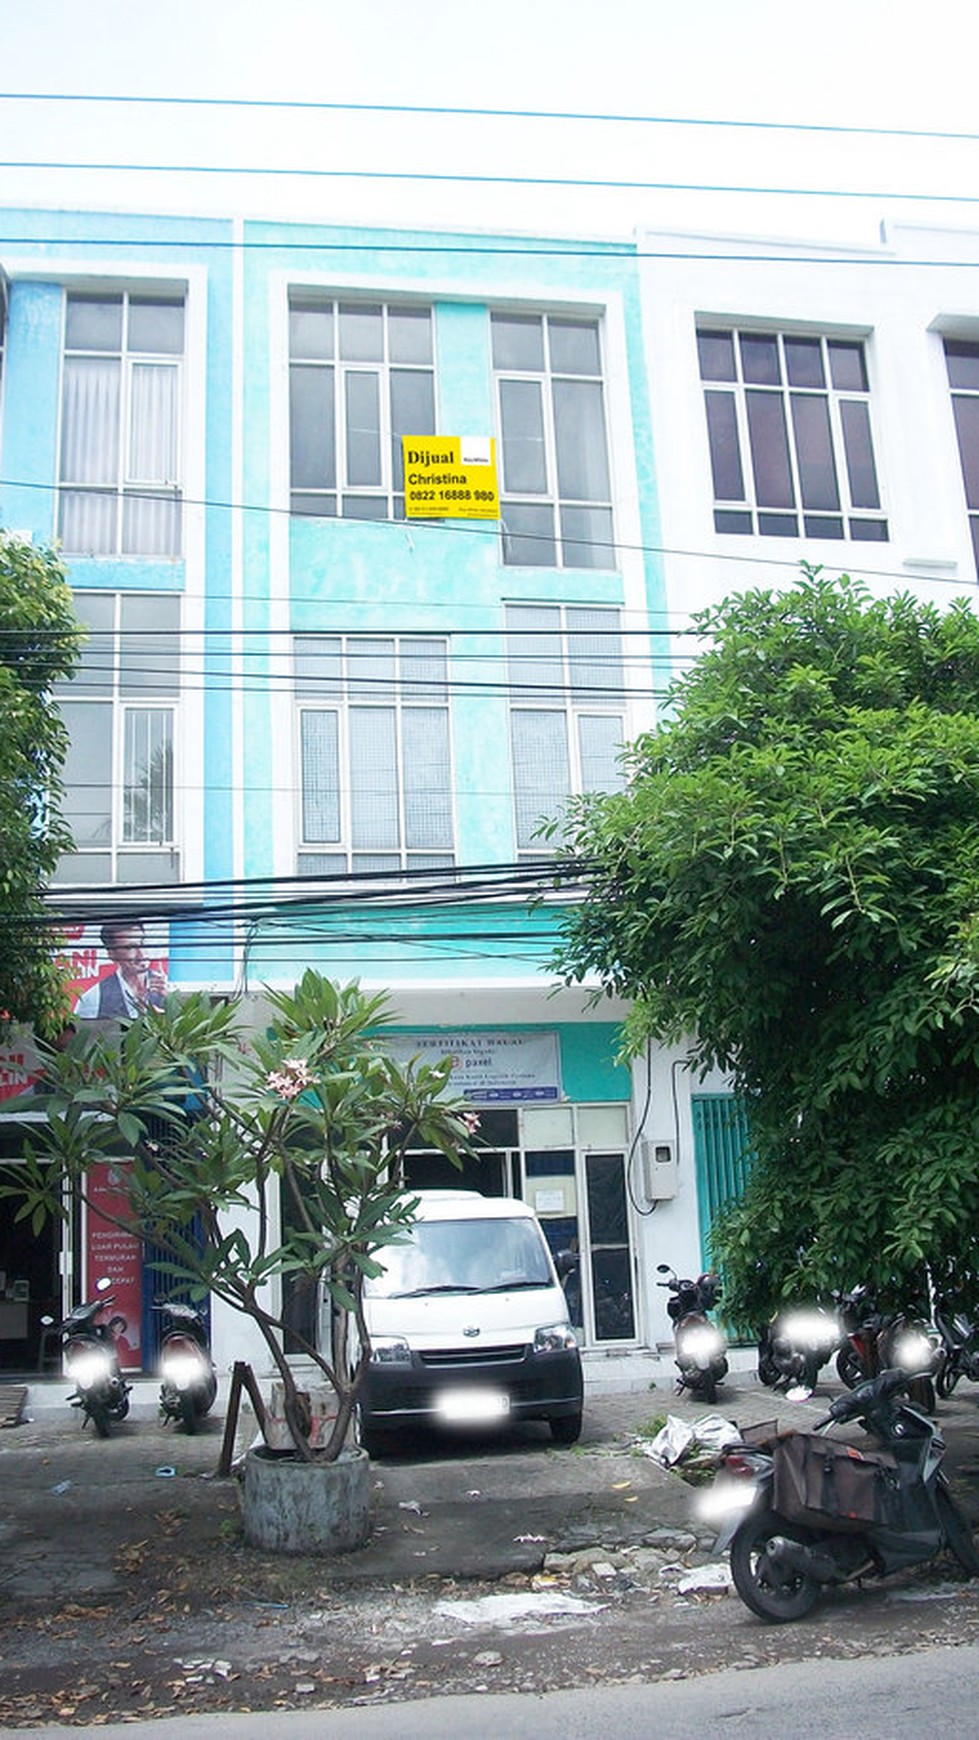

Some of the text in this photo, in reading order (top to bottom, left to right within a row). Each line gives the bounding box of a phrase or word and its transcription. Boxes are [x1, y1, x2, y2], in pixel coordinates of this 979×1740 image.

[408, 451, 454, 467] Dijual
[408, 473, 467, 485] Christina
[409, 490, 495, 502] 0822 16888 980
[465, 1057, 492, 1068] paxel
